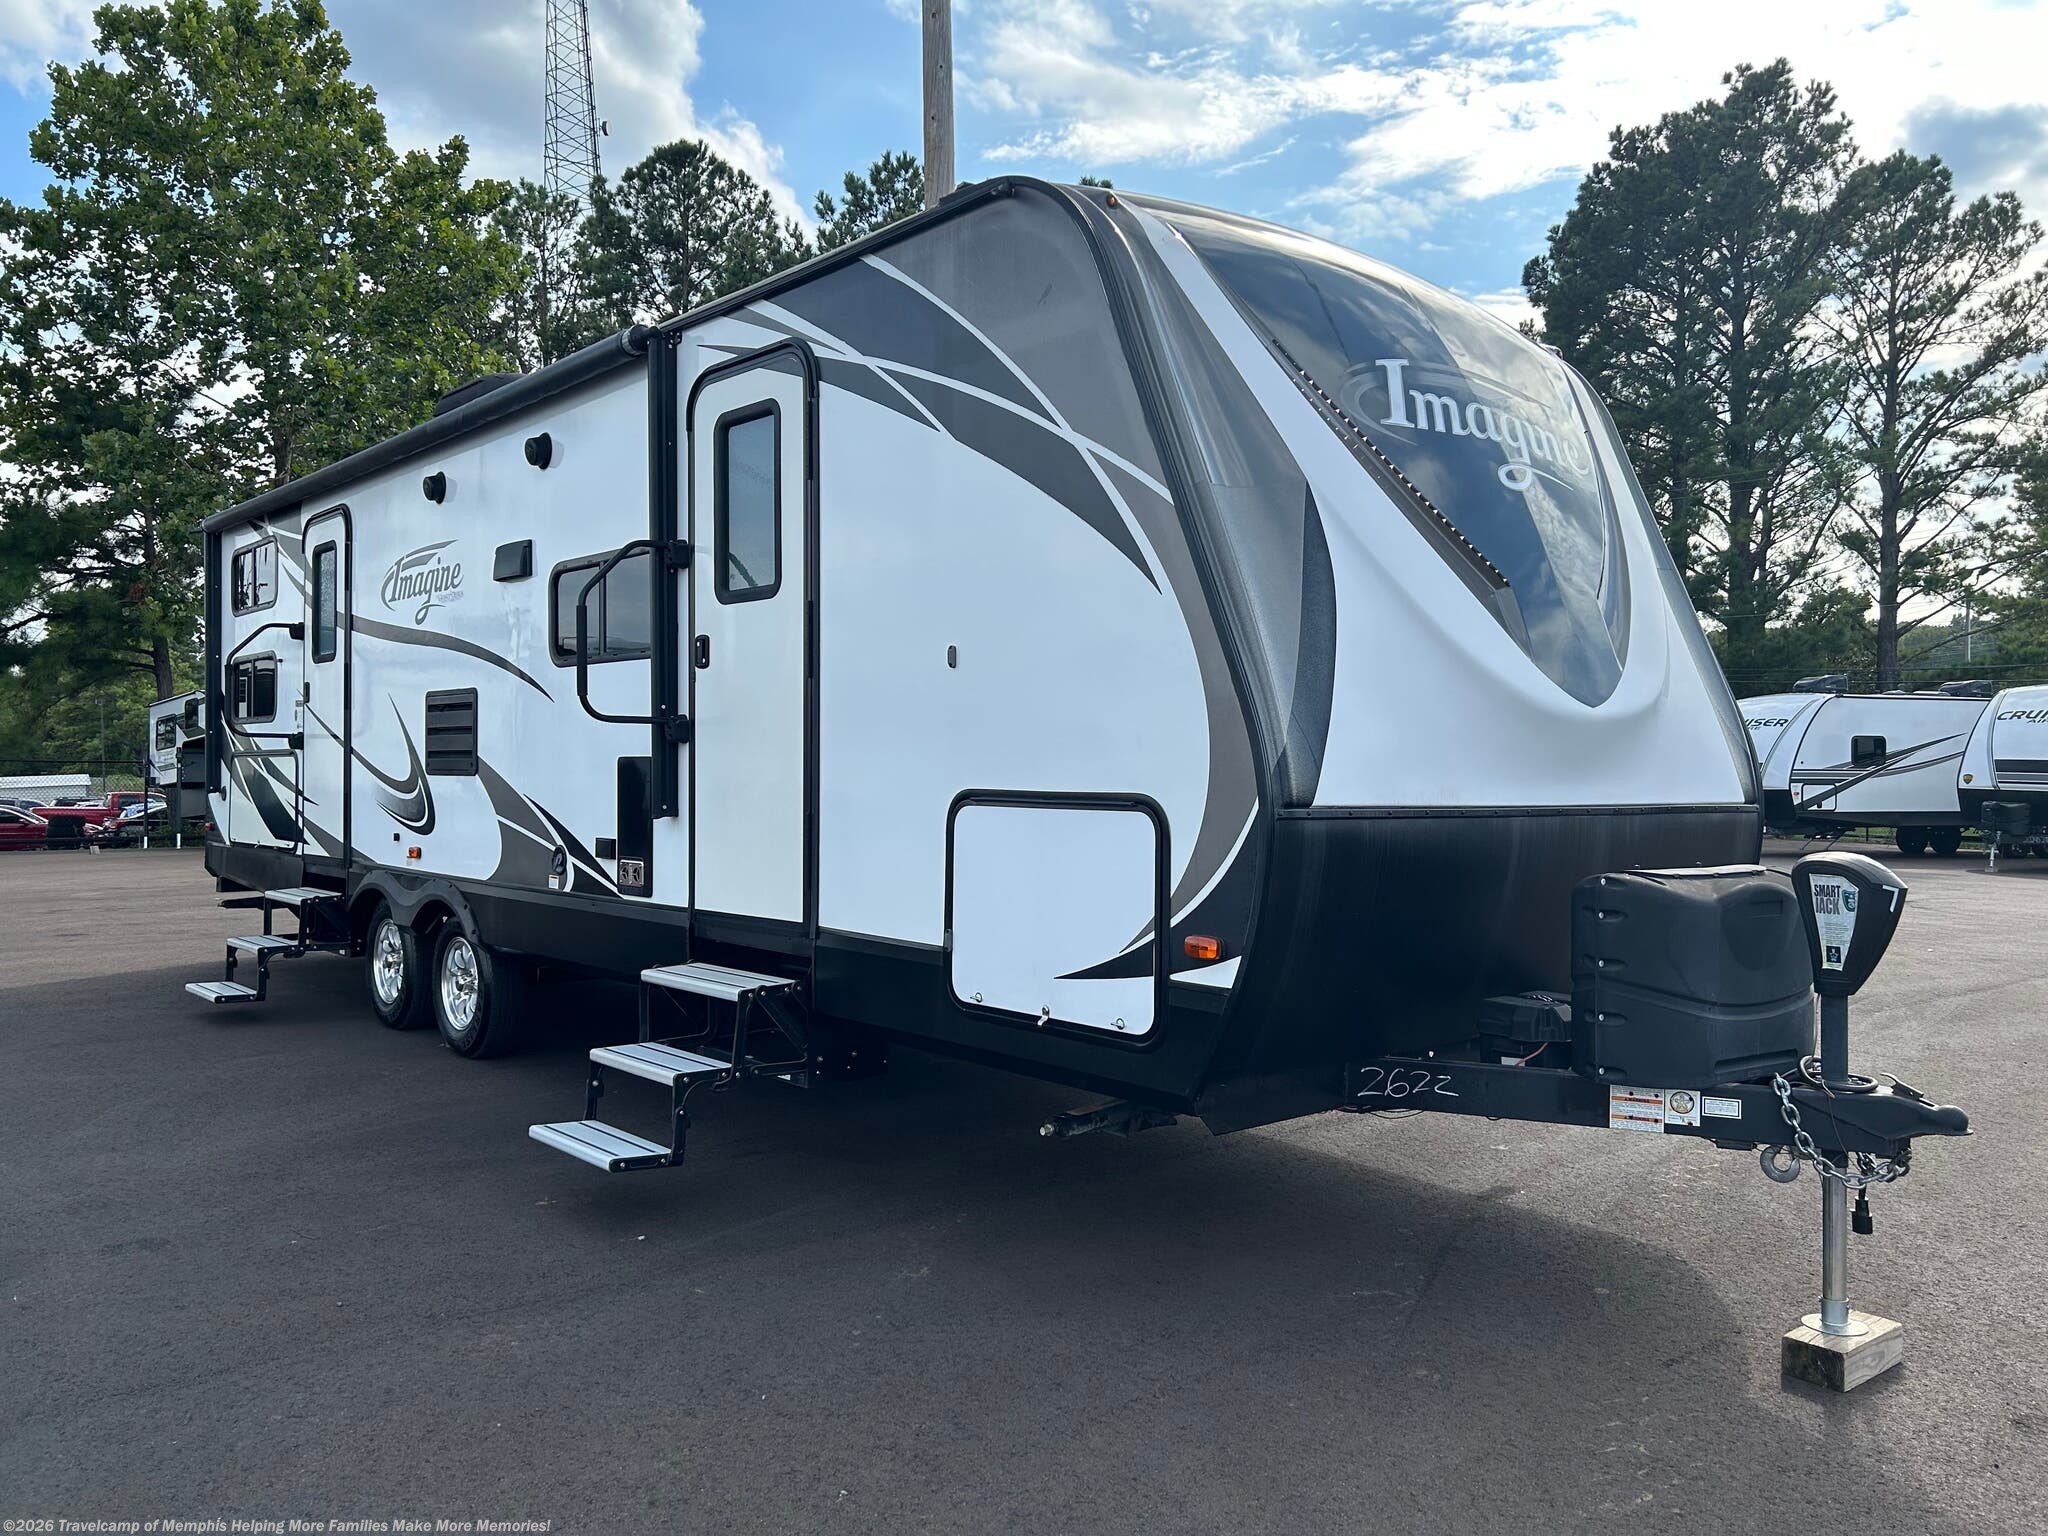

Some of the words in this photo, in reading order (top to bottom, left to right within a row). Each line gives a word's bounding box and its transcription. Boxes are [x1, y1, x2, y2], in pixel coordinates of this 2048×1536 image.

[1374, 357, 1591, 492] Imagine
[387, 555, 465, 626] Imagine
[1813, 884, 1841, 897] SMART
[1815, 898, 1840, 915] JACK
[1357, 1066, 1460, 1098] 2622
